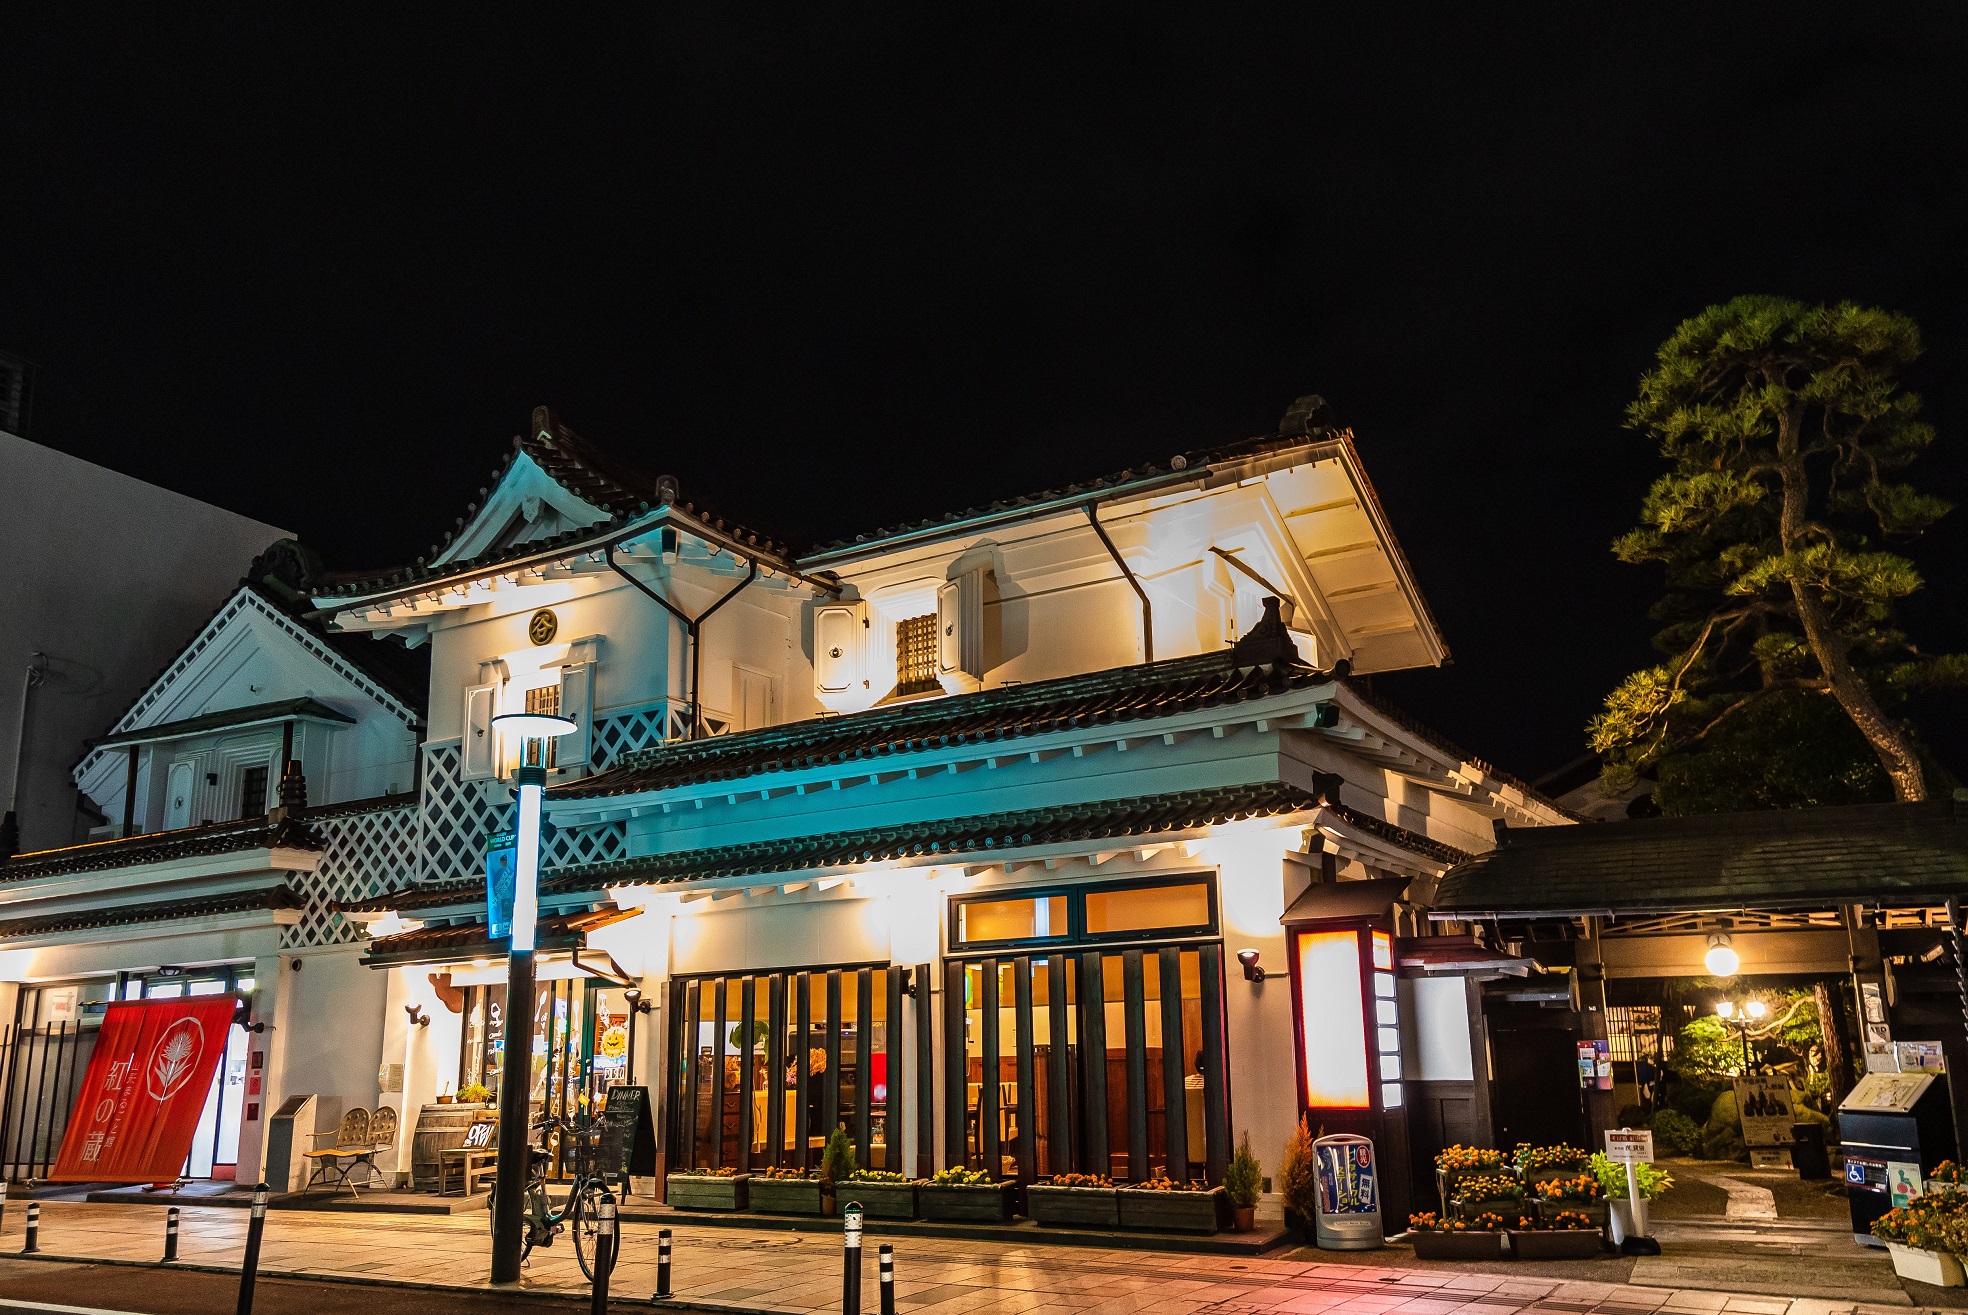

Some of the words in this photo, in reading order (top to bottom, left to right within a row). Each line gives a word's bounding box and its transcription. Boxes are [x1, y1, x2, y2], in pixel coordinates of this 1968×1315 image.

[490, 836, 505, 844] WORLD
[81, 1060, 129, 1162] 紅の蔵
[1337, 1166, 1349, 1212] ステーション
[1360, 1178, 1371, 1199] 無料
